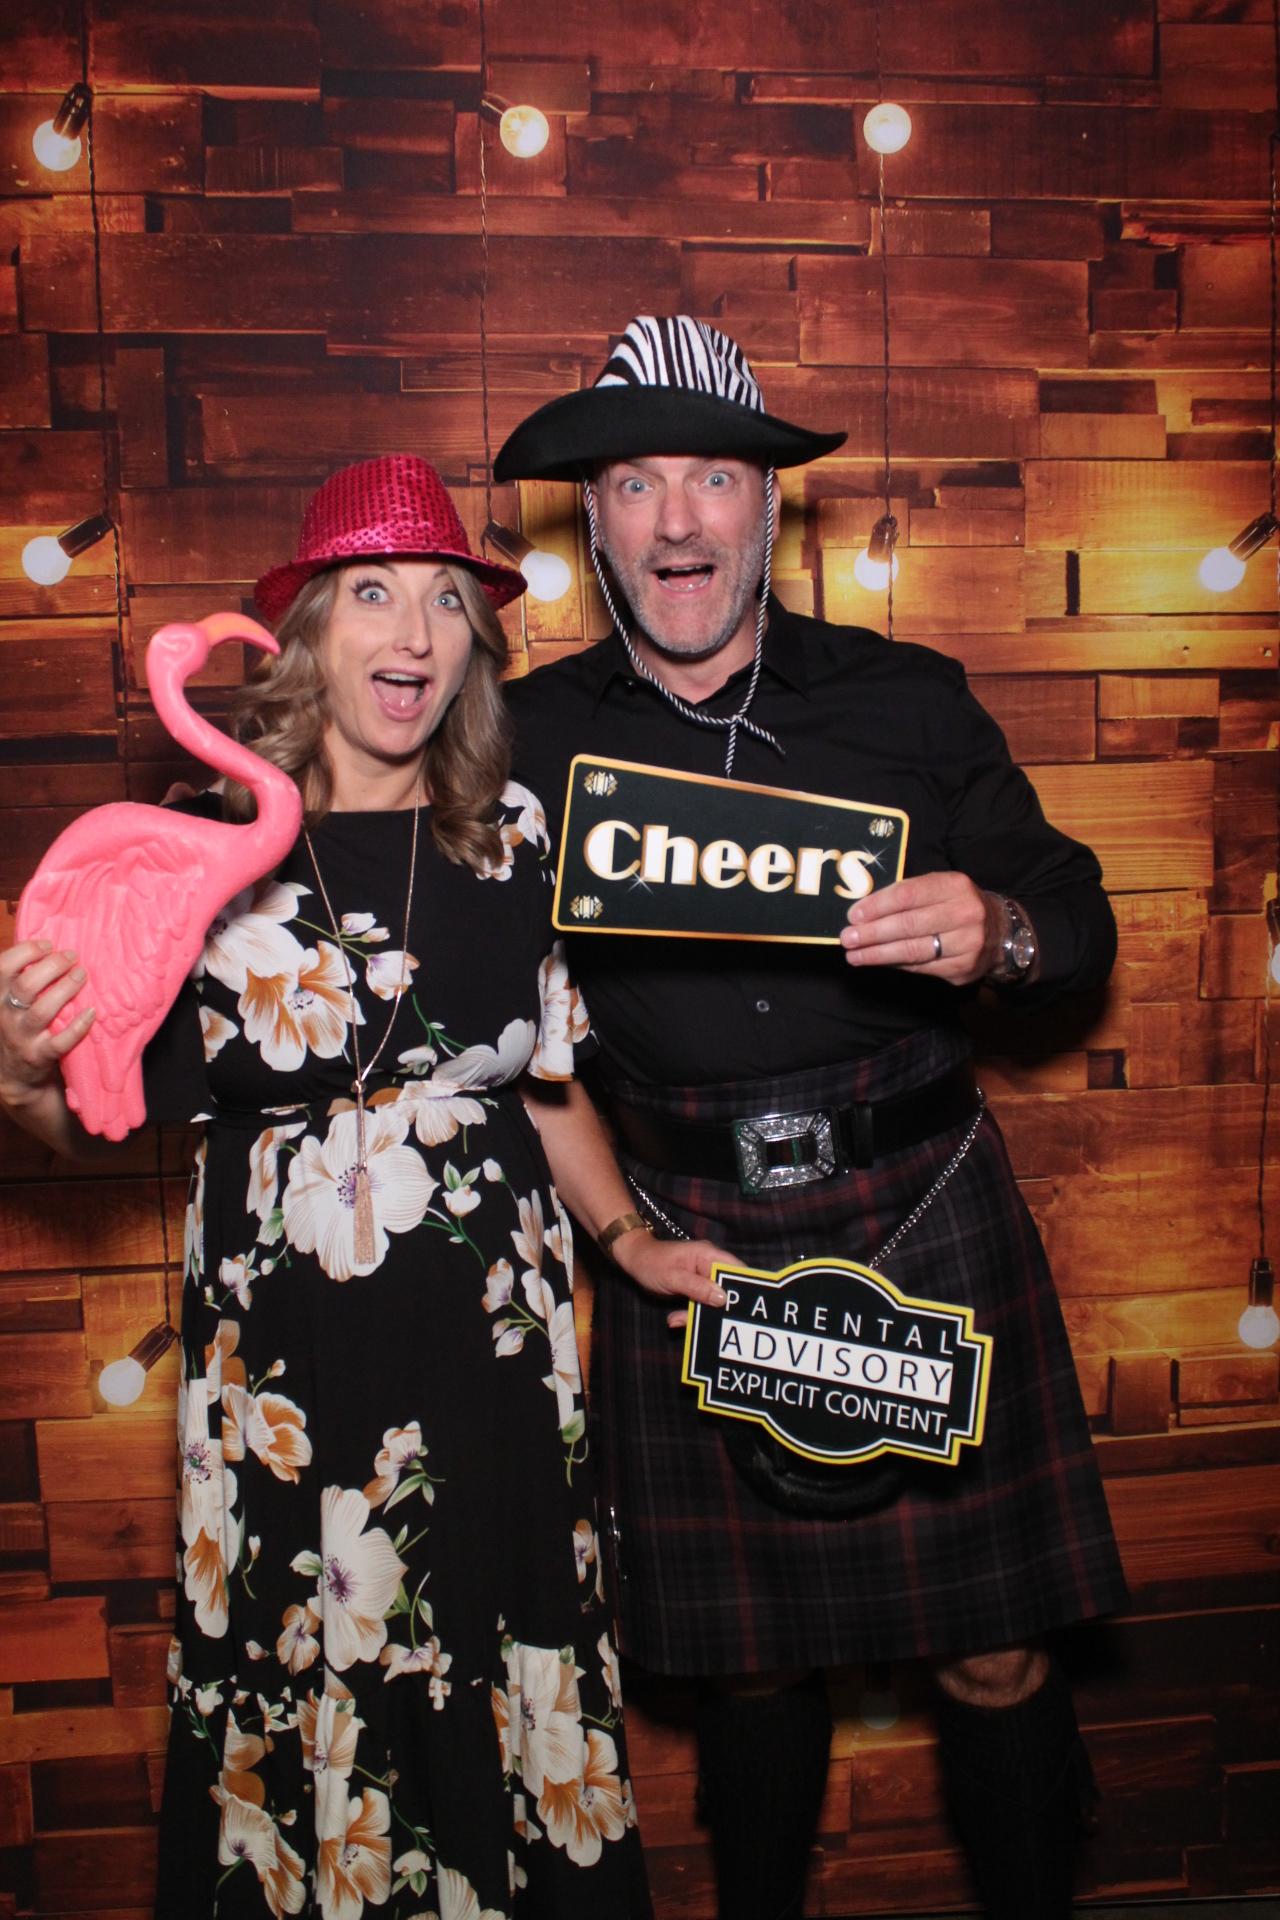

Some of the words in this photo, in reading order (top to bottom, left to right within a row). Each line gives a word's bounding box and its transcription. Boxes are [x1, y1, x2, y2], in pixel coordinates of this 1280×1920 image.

[583, 819, 875, 900] Cheers
[725, 1289, 954, 1355] PARENTAL
[721, 1325, 952, 1397] ADVISORY
[716, 1366, 820, 1409] EXPLICIT
[824, 1390, 948, 1435] CONTENT
